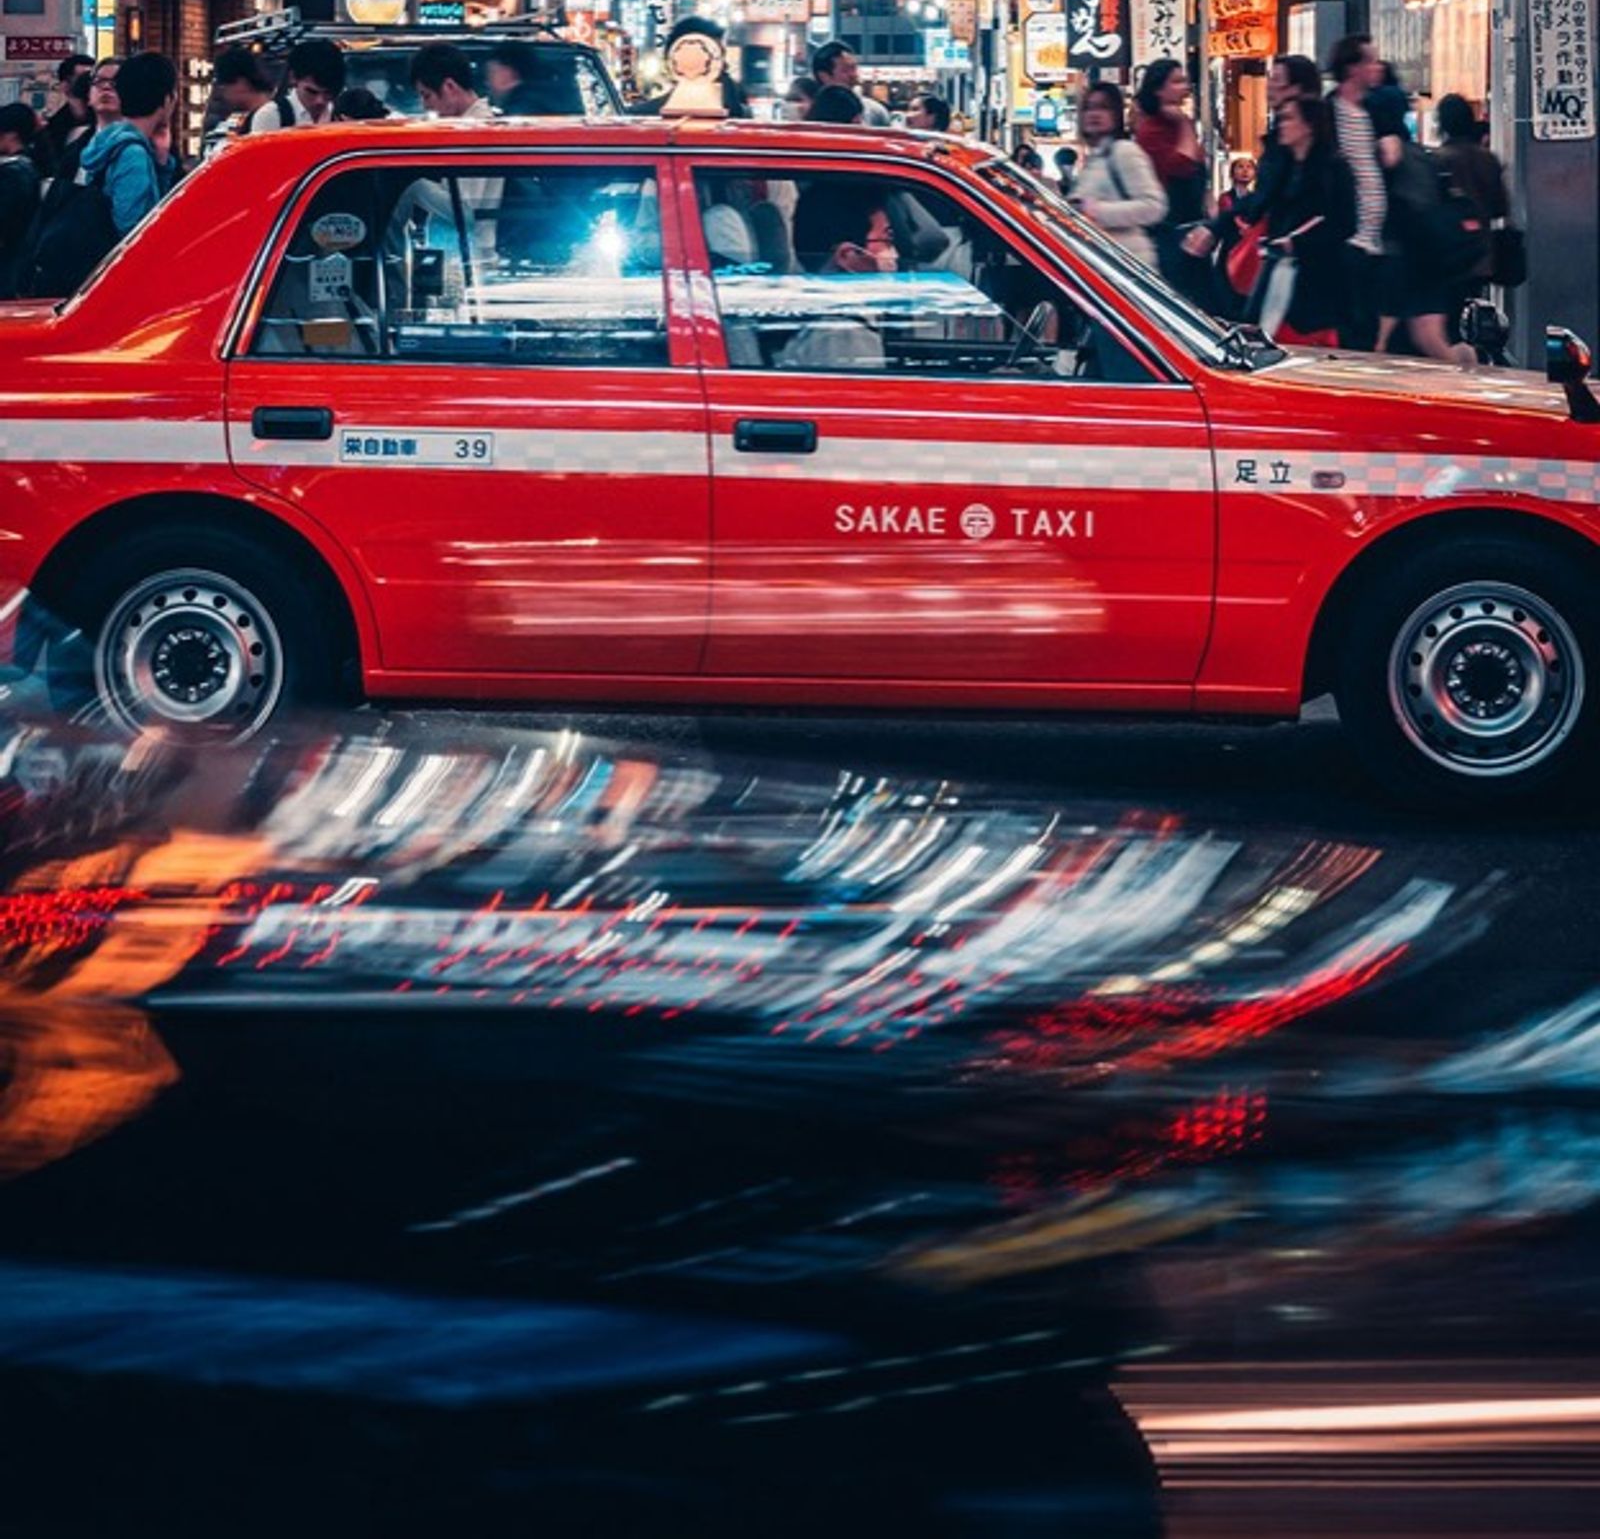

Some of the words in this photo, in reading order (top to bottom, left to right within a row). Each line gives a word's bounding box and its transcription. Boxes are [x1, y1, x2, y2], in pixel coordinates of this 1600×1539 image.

[344, 436, 418, 456] 栄自動車
[455, 439, 488, 459] 39
[1234, 458, 1292, 484] 足立
[834, 504, 946, 534] SAKAE
[1011, 508, 1095, 538] TAXI
